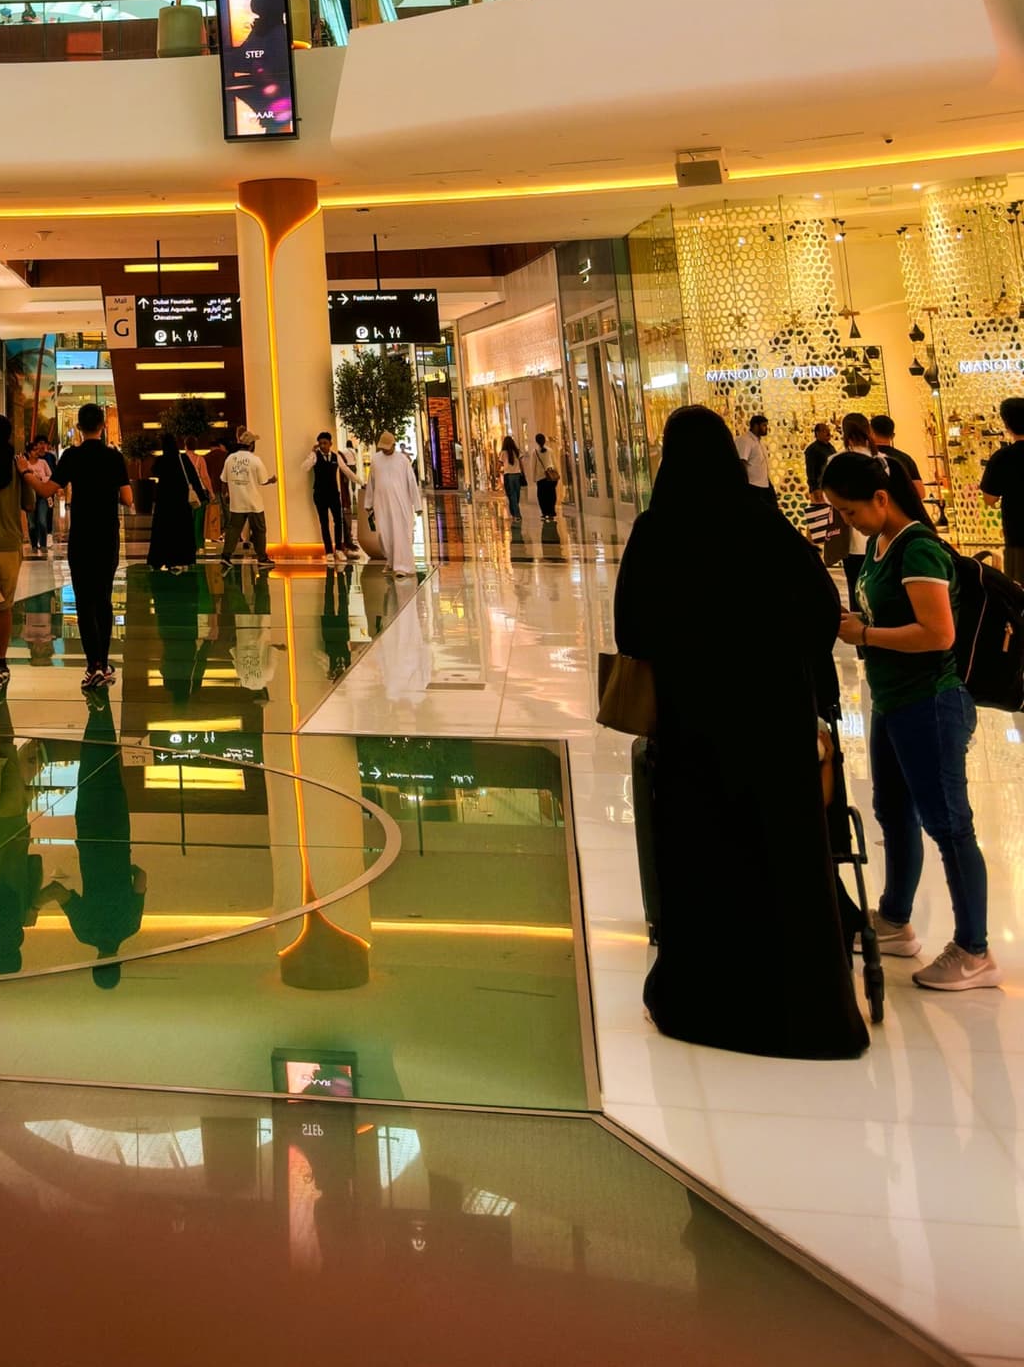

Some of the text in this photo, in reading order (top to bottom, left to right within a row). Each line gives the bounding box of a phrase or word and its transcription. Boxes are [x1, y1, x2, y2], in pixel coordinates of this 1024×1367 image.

[245, 50, 265, 59] STEP
[170, 306, 198, 314] Aquarium
[113, 319, 129, 337] G
[706, 369, 768, 383] MANOLO
